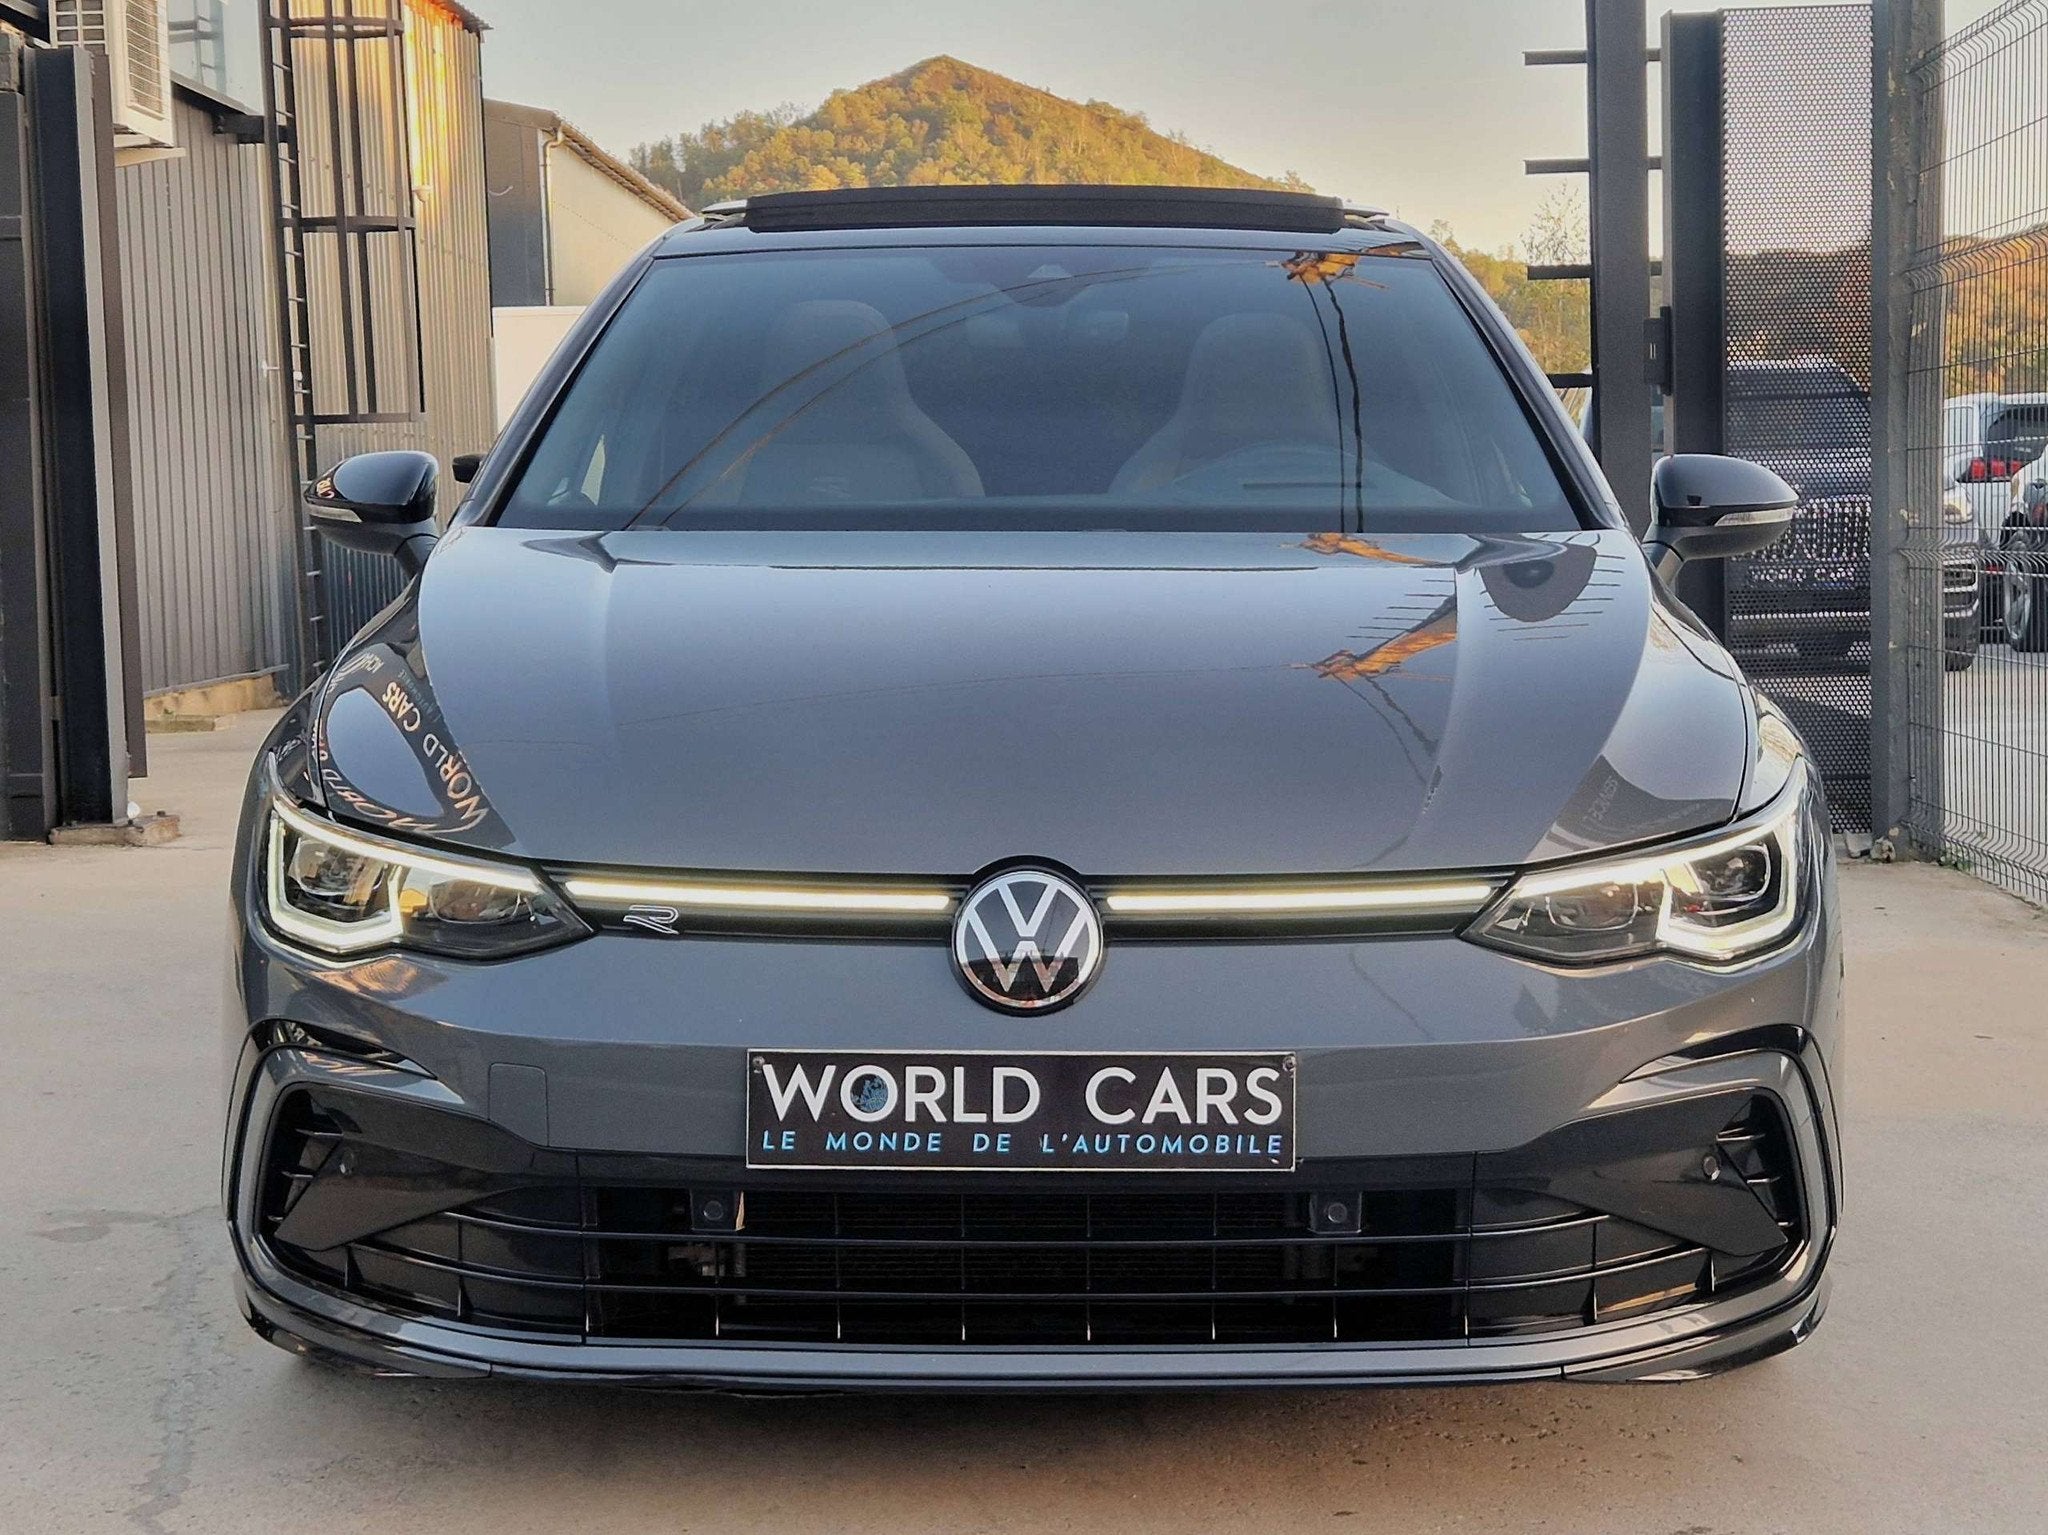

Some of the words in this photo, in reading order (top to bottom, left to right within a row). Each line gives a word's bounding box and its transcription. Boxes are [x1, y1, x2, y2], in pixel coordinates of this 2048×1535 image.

[382, 681, 421, 732] CARS
[422, 733, 489, 829] WORLD
[763, 1064, 1041, 1123] WORLD
[1085, 1066, 1282, 1125] CARS
[762, 1131, 796, 1150] LE
[826, 1132, 942, 1152] MONDE
[973, 1134, 1012, 1153] DE
[1042, 1134, 1283, 1154] L'AUTOMOBILE
